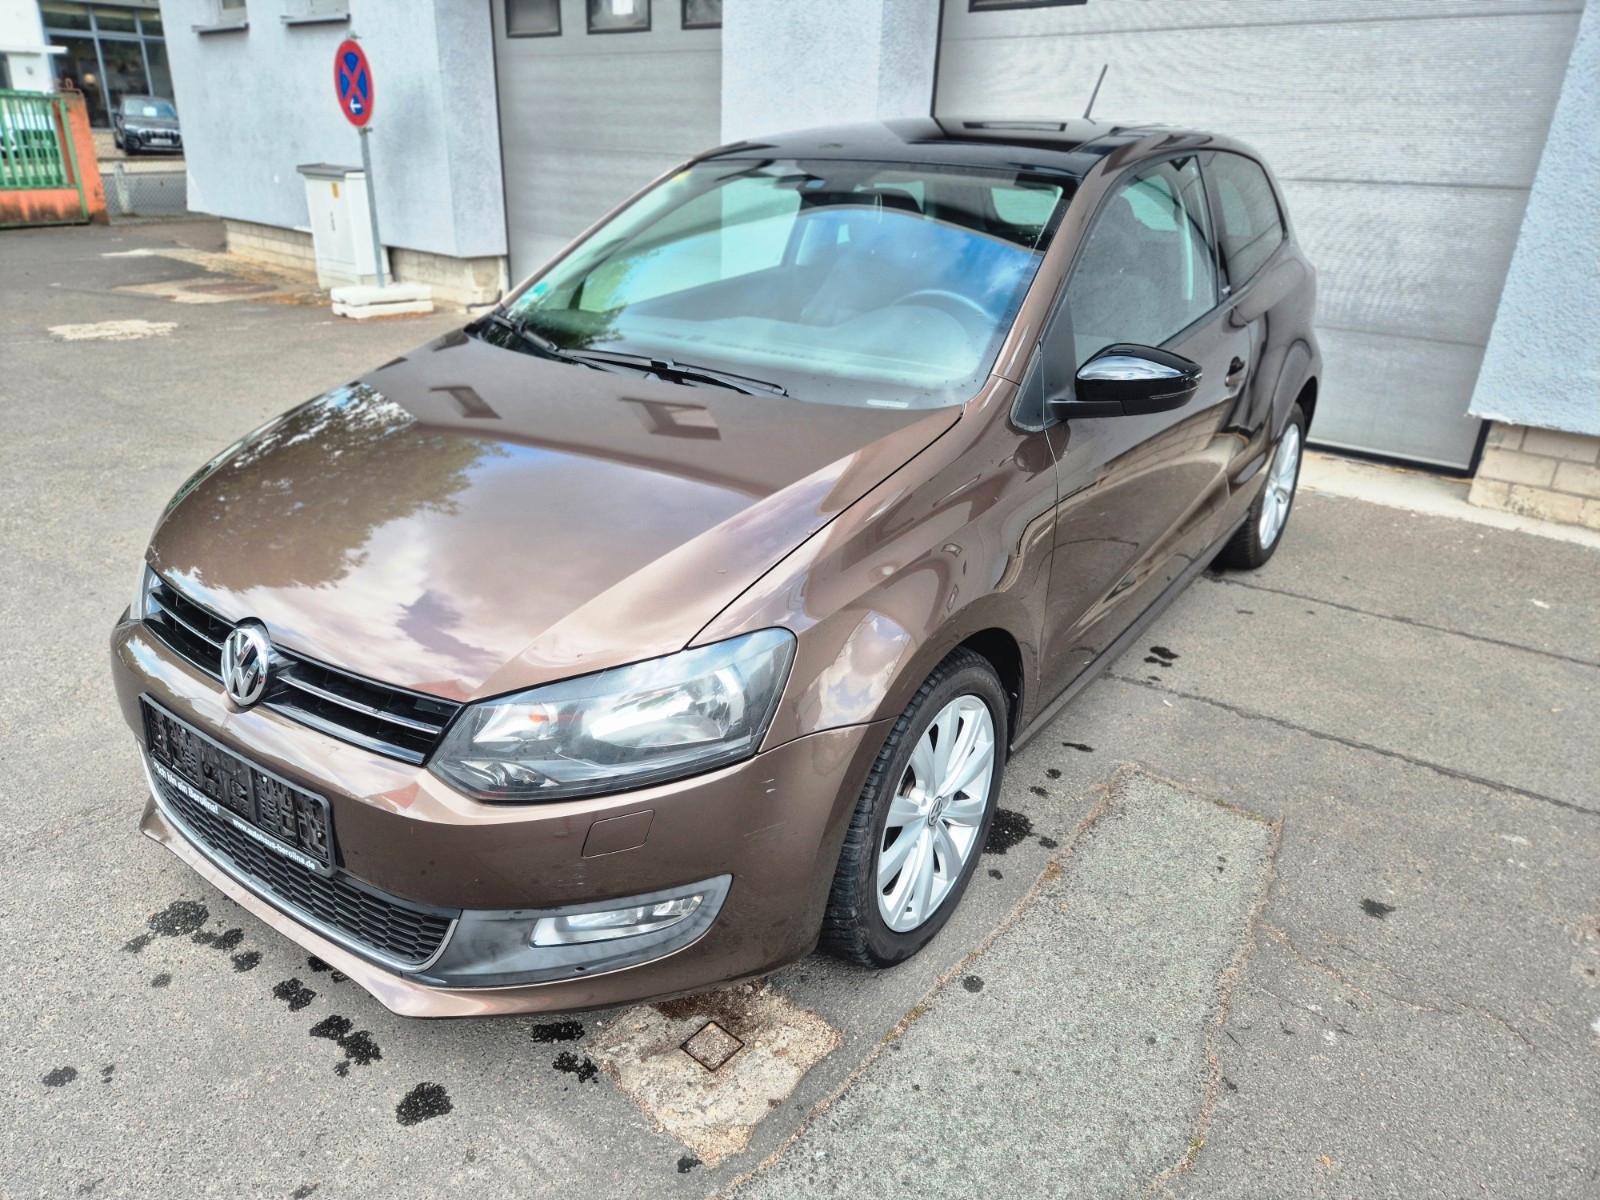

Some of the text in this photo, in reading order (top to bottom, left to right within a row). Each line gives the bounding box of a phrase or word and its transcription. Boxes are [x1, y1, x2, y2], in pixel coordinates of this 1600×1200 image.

[167, 771, 178, 787] bin
[177, 781, 188, 795] ein
[231, 818, 316, 870] www.autohaus-berolina.de
